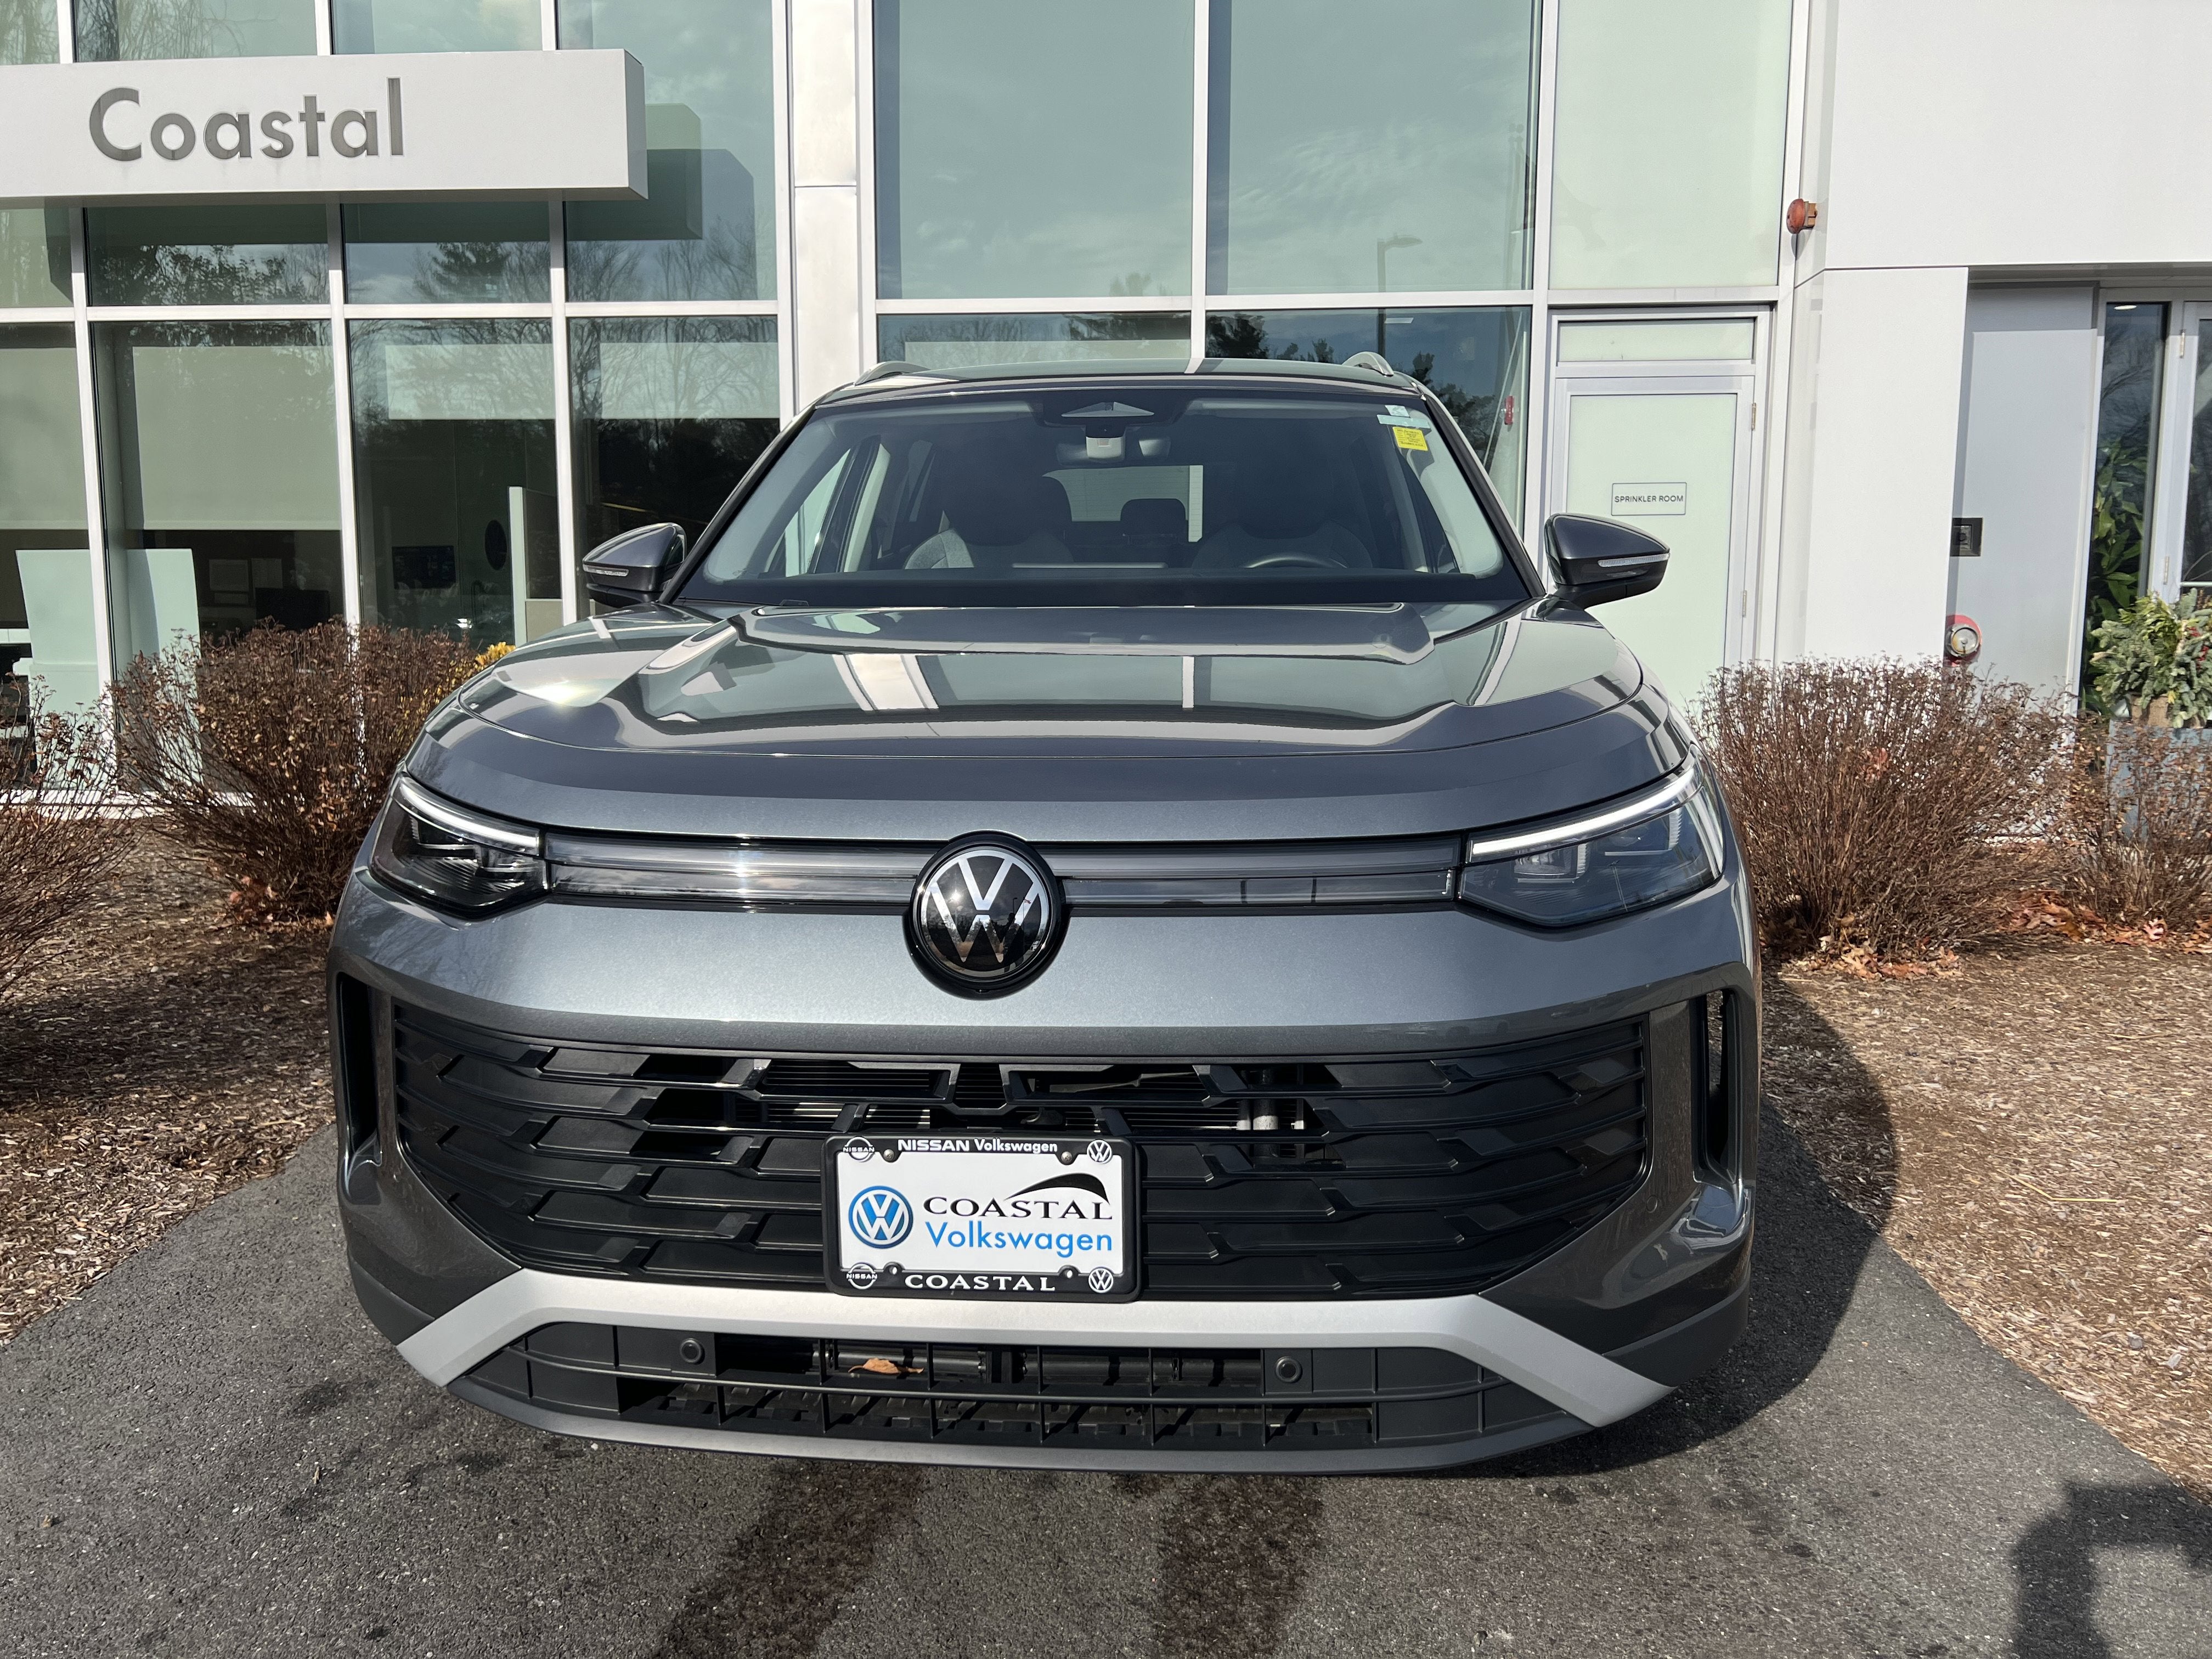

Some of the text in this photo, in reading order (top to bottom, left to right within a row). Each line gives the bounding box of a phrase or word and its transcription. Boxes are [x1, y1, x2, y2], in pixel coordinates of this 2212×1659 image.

[89, 77, 403, 161] Coastal
[923, 850, 1047, 972] VW
[898, 1137, 1058, 1154] NISSAN Volkswagen
[1087, 1140, 1112, 1163] VW
[850, 1187, 913, 1248] VW
[923, 1197, 1113, 1220] COASTAL
[925, 1220, 1113, 1258] Volkswagen
[905, 1274, 1056, 1292] COASTAL
[1088, 1268, 1113, 1293] VW
